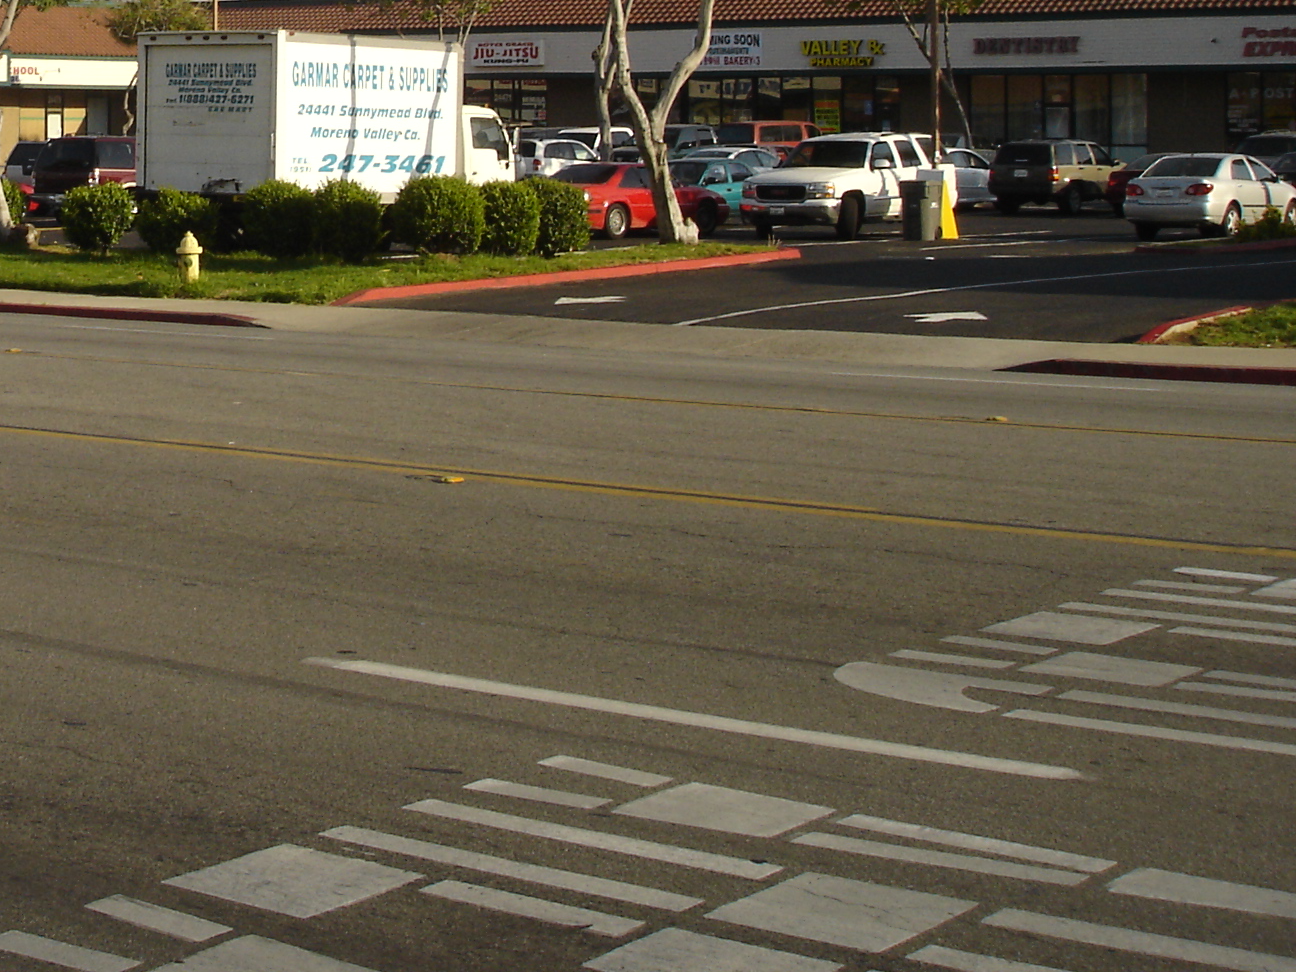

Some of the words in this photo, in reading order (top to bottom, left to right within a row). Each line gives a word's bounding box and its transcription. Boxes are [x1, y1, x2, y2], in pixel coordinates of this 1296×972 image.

[733, 34, 760, 47] SOON
[800, 39, 863, 56] VALLEY
[972, 35, 1081, 55] DENTISTRY
[473, 46, 539, 60] JIU-JITSU
[809, 56, 874, 67] PHARMACY
[165, 63, 192, 78] GARMAR
[193, 63, 218, 78] CARPET
[225, 63, 257, 78] SUPPLIES
[292, 61, 339, 88] GARMAR
[343, 63, 385, 90] CARPET
[388, 66, 395, 91] &
[398, 66, 449, 93] SUPPLIES
[297, 104, 336, 116] 24441
[339, 105, 411, 119] Sunnymead
[414, 108, 444, 120] Blvd.
[310, 127, 359, 139] Moreno
[363, 128, 402, 142] Valley
[404, 129, 421, 141] Ca.
[318, 154, 446, 174] 247-3461
